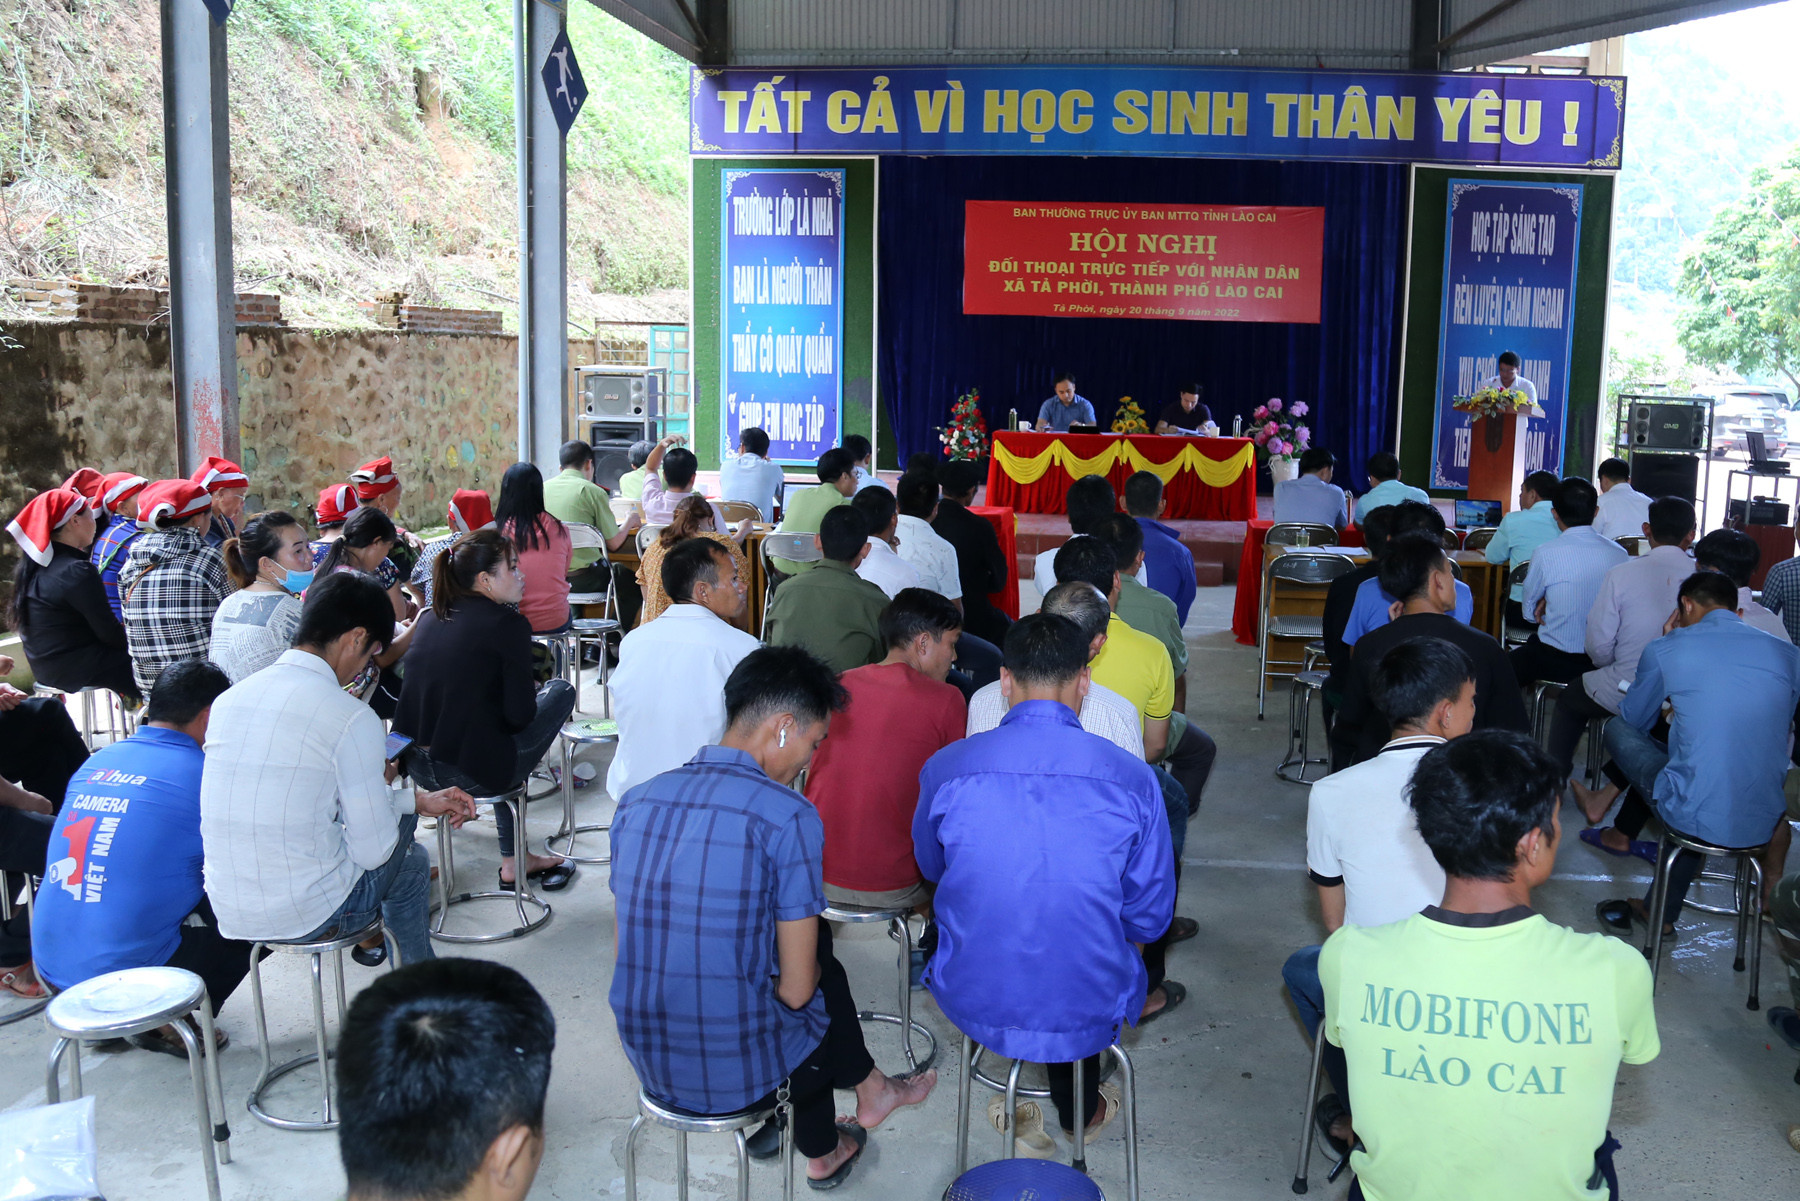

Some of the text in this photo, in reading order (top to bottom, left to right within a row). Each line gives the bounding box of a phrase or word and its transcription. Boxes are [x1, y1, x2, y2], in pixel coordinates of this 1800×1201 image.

[718, 76, 1578, 146] TẤT CẢ VÌ HỌC SINH THÂN YÊU !
[733, 187, 833, 236] TRƯỜNG LỚP LÀ NHÀ
[1013, 206, 1277, 222] BAN THƯỜNG TRỰC ỦY BAN MTTQ TỈNH LÀO CAI
[1470, 203, 1556, 265] HỌC TẬP SÁNG TẠO
[1069, 228, 1217, 261] HỘI NGHỊ
[733, 256, 832, 313] BẠN LÀ NGƯỜI THÂN
[988, 257, 1300, 280] ĐỐI THOẠI TRỰC TIẾP VỚI NHÂN DÂN
[1003, 278, 1283, 299] XÃ TẢ PHỜI, THÀNH PHỐ LÀO CAI
[1053, 304, 1066, 312] Tả
[1099, 306, 1126, 315] ngày
[1144, 306, 1175, 317] tháng
[1178, 307, 1184, 316] 9
[1214, 308, 1240, 317] 2022
[1453, 274, 1565, 335] RÈN LUYỆN CHĂM NGOAN
[760, 326, 773, 373] CÔ
[776, 326, 802, 378] QUÂY
[1458, 356, 1474, 397] VUI
[764, 402, 780, 441] EM
[782, 402, 803, 450] HỌC
[805, 395, 825, 451] TẬP
[72, 794, 130, 814] CAMERA
[91, 816, 122, 857] NAM
[85, 862, 108, 903] VIỆT
[1360, 983, 1592, 1045] MOBIFONE
[1381, 1044, 1567, 1095] LÀO CAI
